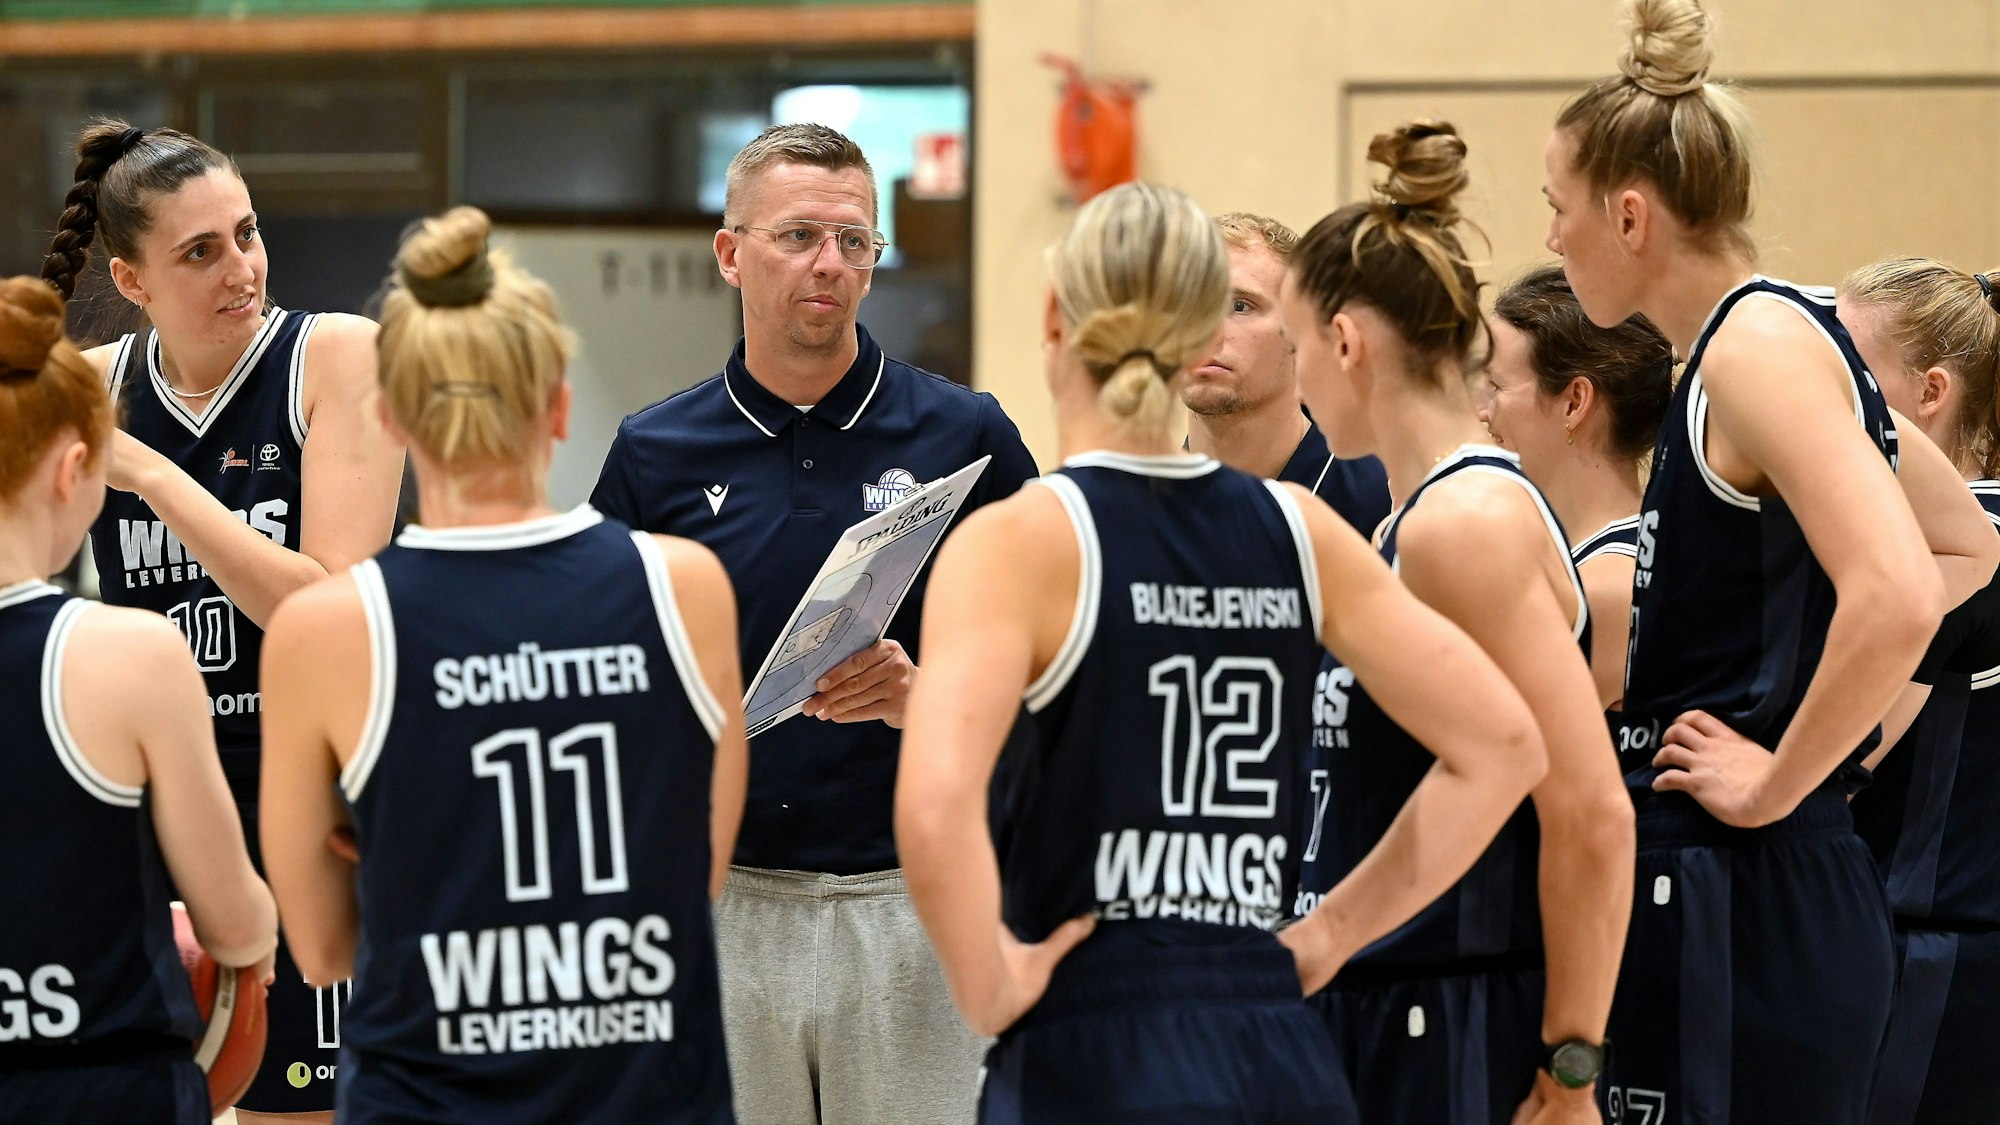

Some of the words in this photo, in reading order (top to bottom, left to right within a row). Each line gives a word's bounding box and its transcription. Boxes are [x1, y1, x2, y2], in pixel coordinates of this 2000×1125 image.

[118, 497, 289, 571] WIS
[848, 491, 954, 560] SPALDING
[166, 595, 237, 673] 10
[1129, 581, 1302, 630] BLAZEJEWSKI
[432, 641, 651, 710] SCHÜTTER
[1148, 654, 1284, 820] 12
[470, 721, 630, 903] 11
[1094, 828, 1288, 911] WINGS
[420, 914, 676, 1013] WINGS
[436, 999, 675, 1055] LEVERKUSEN
